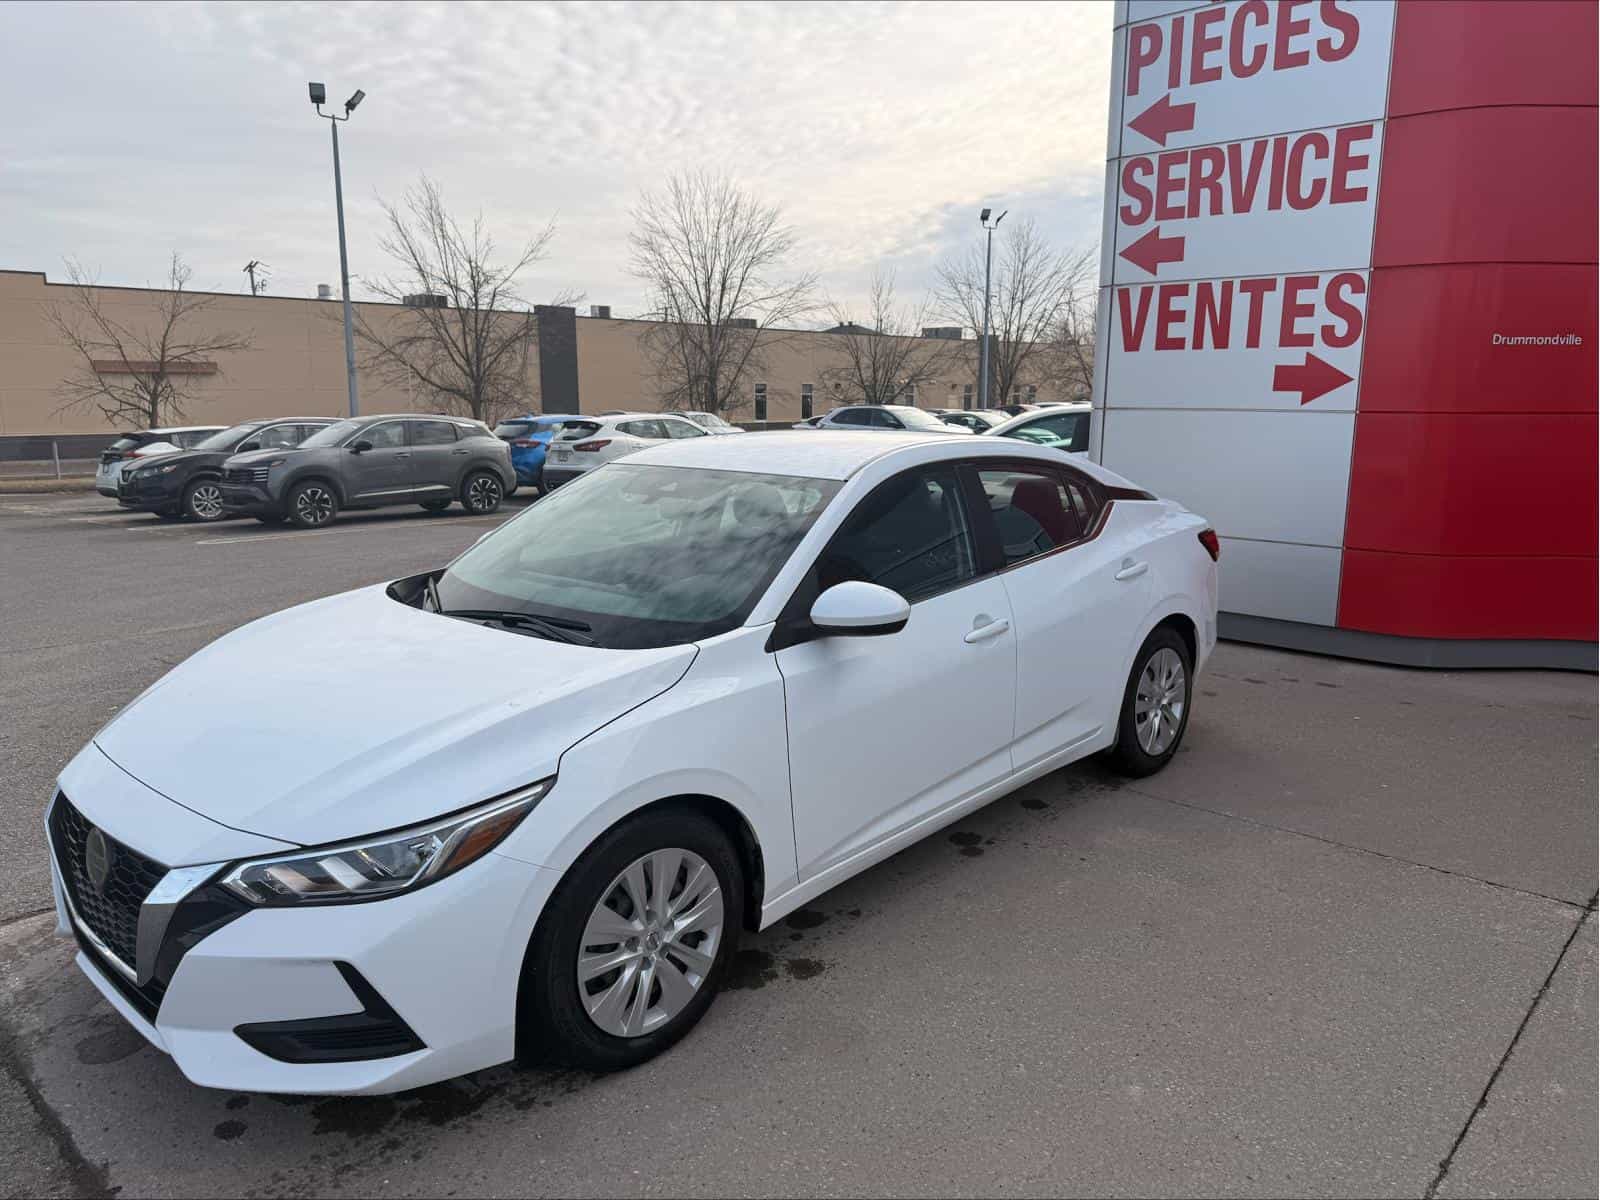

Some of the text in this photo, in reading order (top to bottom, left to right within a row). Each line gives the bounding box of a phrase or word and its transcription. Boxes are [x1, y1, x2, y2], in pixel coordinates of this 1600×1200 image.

[1120, 125, 1373, 226] SERVICE
[1117, 273, 1366, 352] VENTES
[1492, 333, 1582, 345] Drummondville
